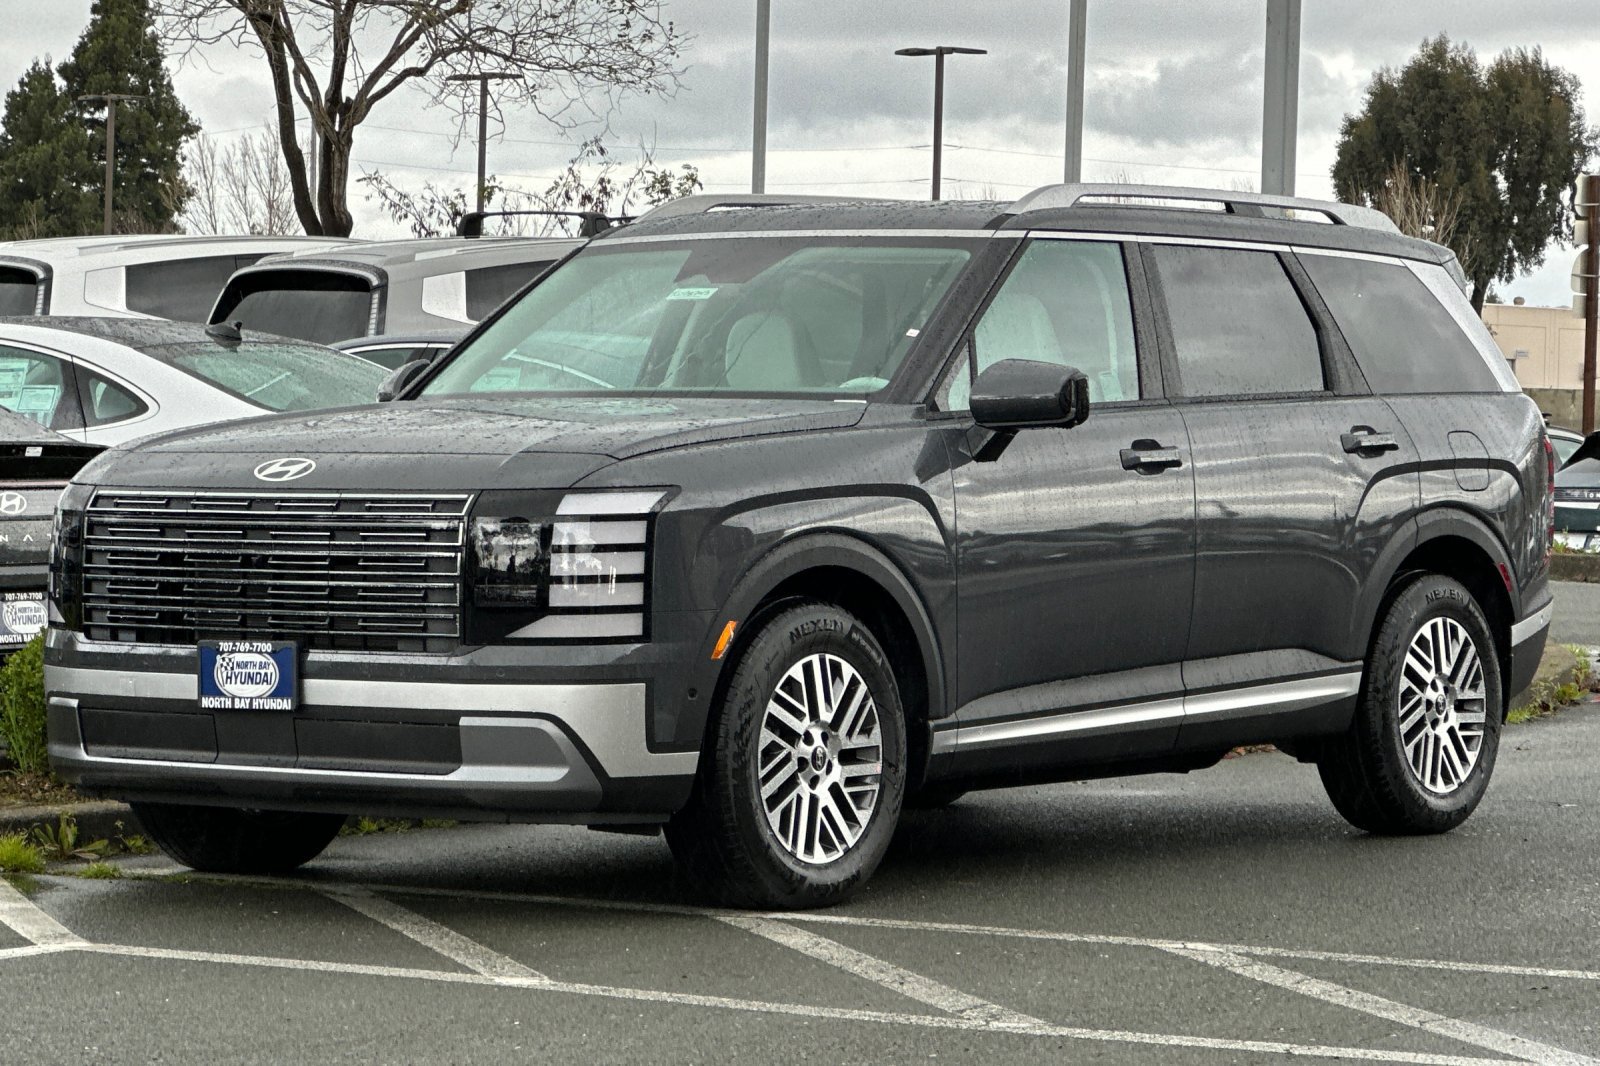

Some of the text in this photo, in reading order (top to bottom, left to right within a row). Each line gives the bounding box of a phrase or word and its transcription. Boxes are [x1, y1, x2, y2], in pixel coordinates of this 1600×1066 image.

[1425, 589, 1464, 604] NEXEN
[12, 614, 45, 626] HYUNDAI
[789, 619, 844, 644] NEXEN
[218, 642, 272, 652] 707-769-7700
[235, 660, 272, 670] NORTH BAY
[225, 671, 273, 685] HYUNDAI
[202, 697, 292, 710] NORTH BAY HYUNDAI
